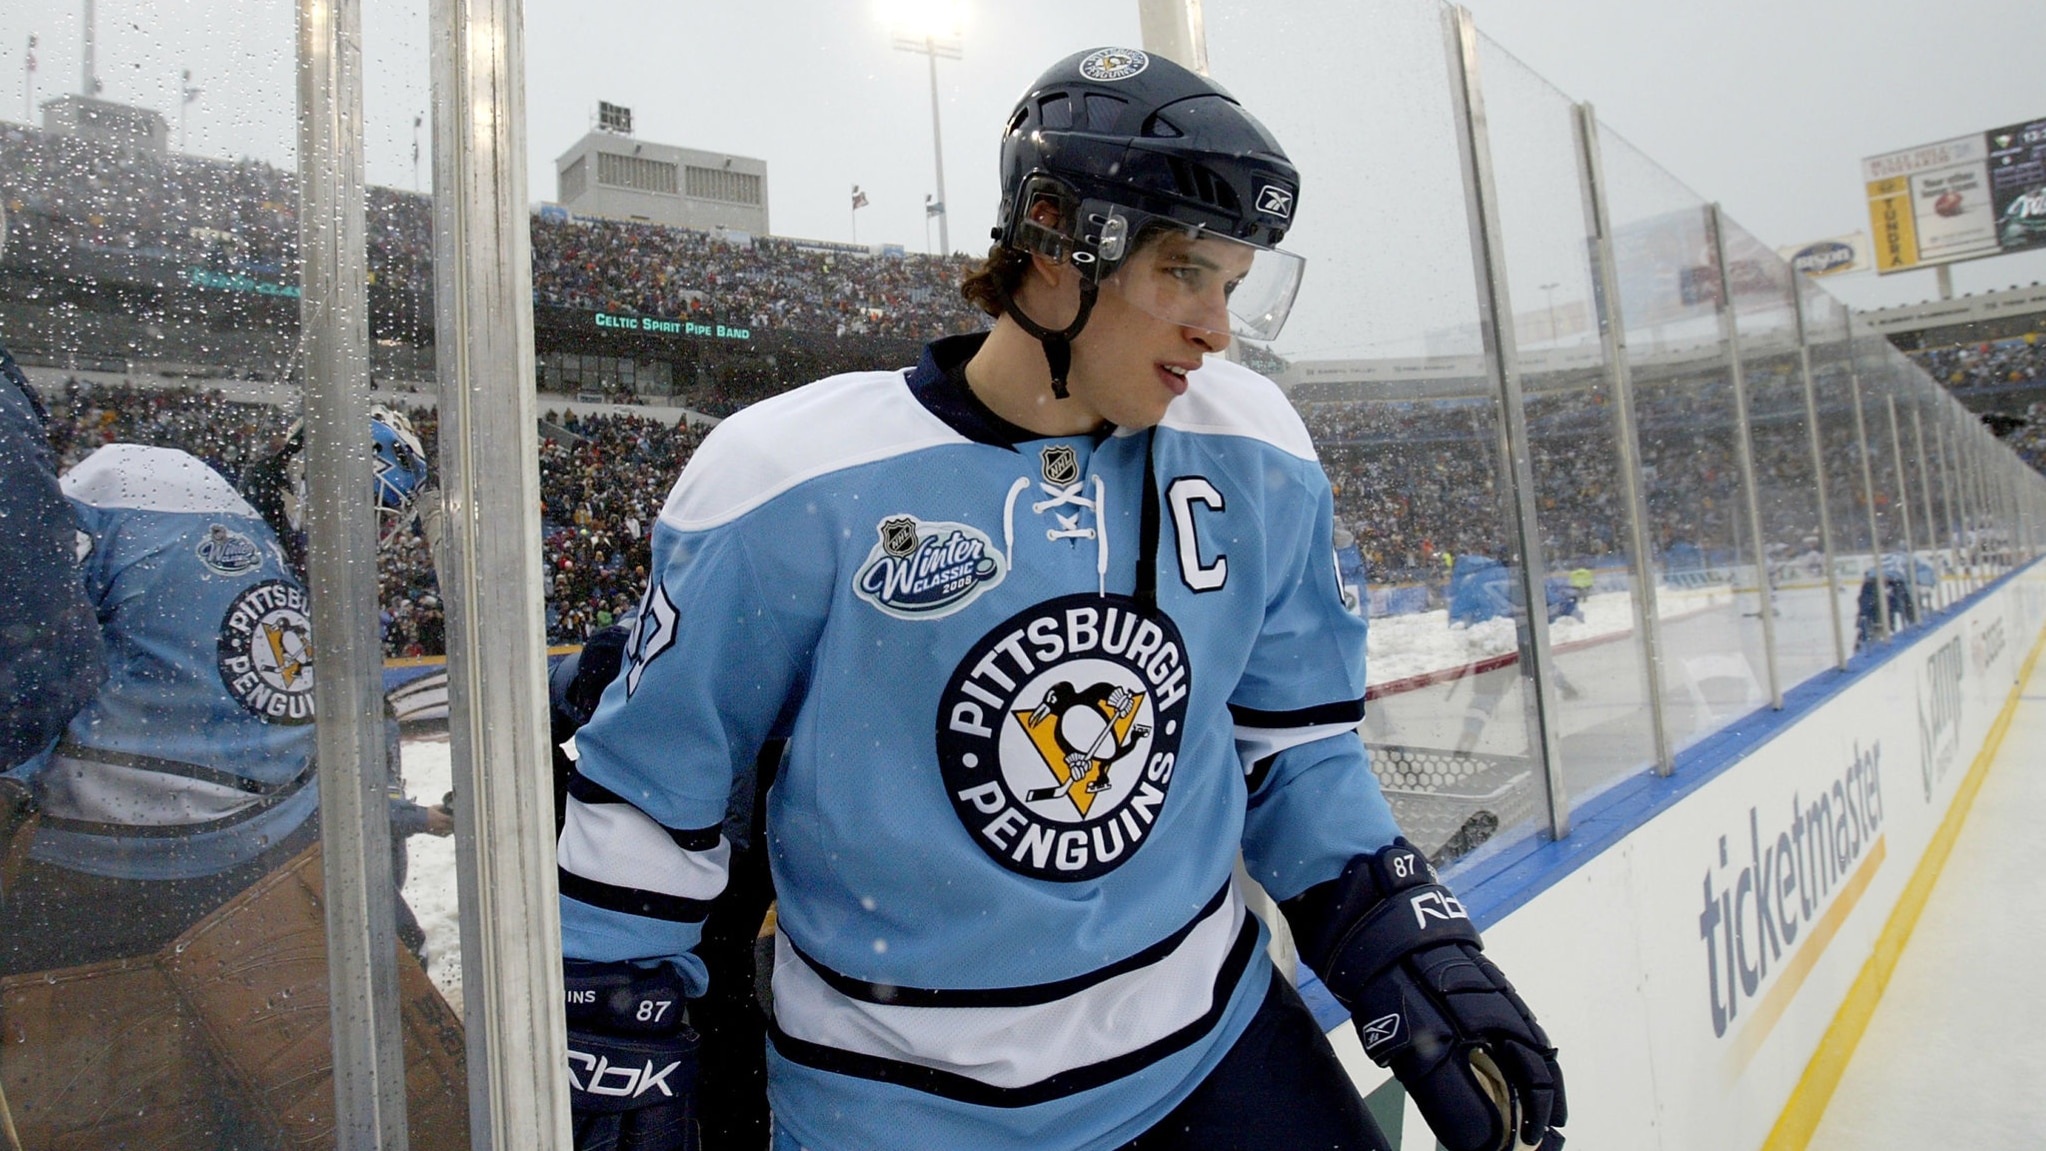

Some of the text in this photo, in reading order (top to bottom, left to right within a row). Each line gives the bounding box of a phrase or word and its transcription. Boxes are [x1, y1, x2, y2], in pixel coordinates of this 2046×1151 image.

[1884, 198, 1903, 266] TUNDRA
[595, 313, 749, 339] CELTIC SPIRIT PIPE BAND
[1050, 453, 1071, 478] NHL
[1165, 475, 1228, 594] C
[862, 531, 983, 600] Winter
[913, 561, 974, 594] CLASSIC
[942, 576, 972, 594] 2008
[229, 584, 311, 635] PITTSBU
[224, 655, 315, 718] PENGUI
[949, 607, 1187, 738] PITTSBURGH
[958, 752, 1174, 870] PENGUINS
[1393, 853, 1415, 877] 87
[1410, 890, 1469, 930] Rb
[1700, 738, 1883, 1038] ticketmaster
[567, 990, 596, 1003] INS
[636, 1000, 671, 1022] 87
